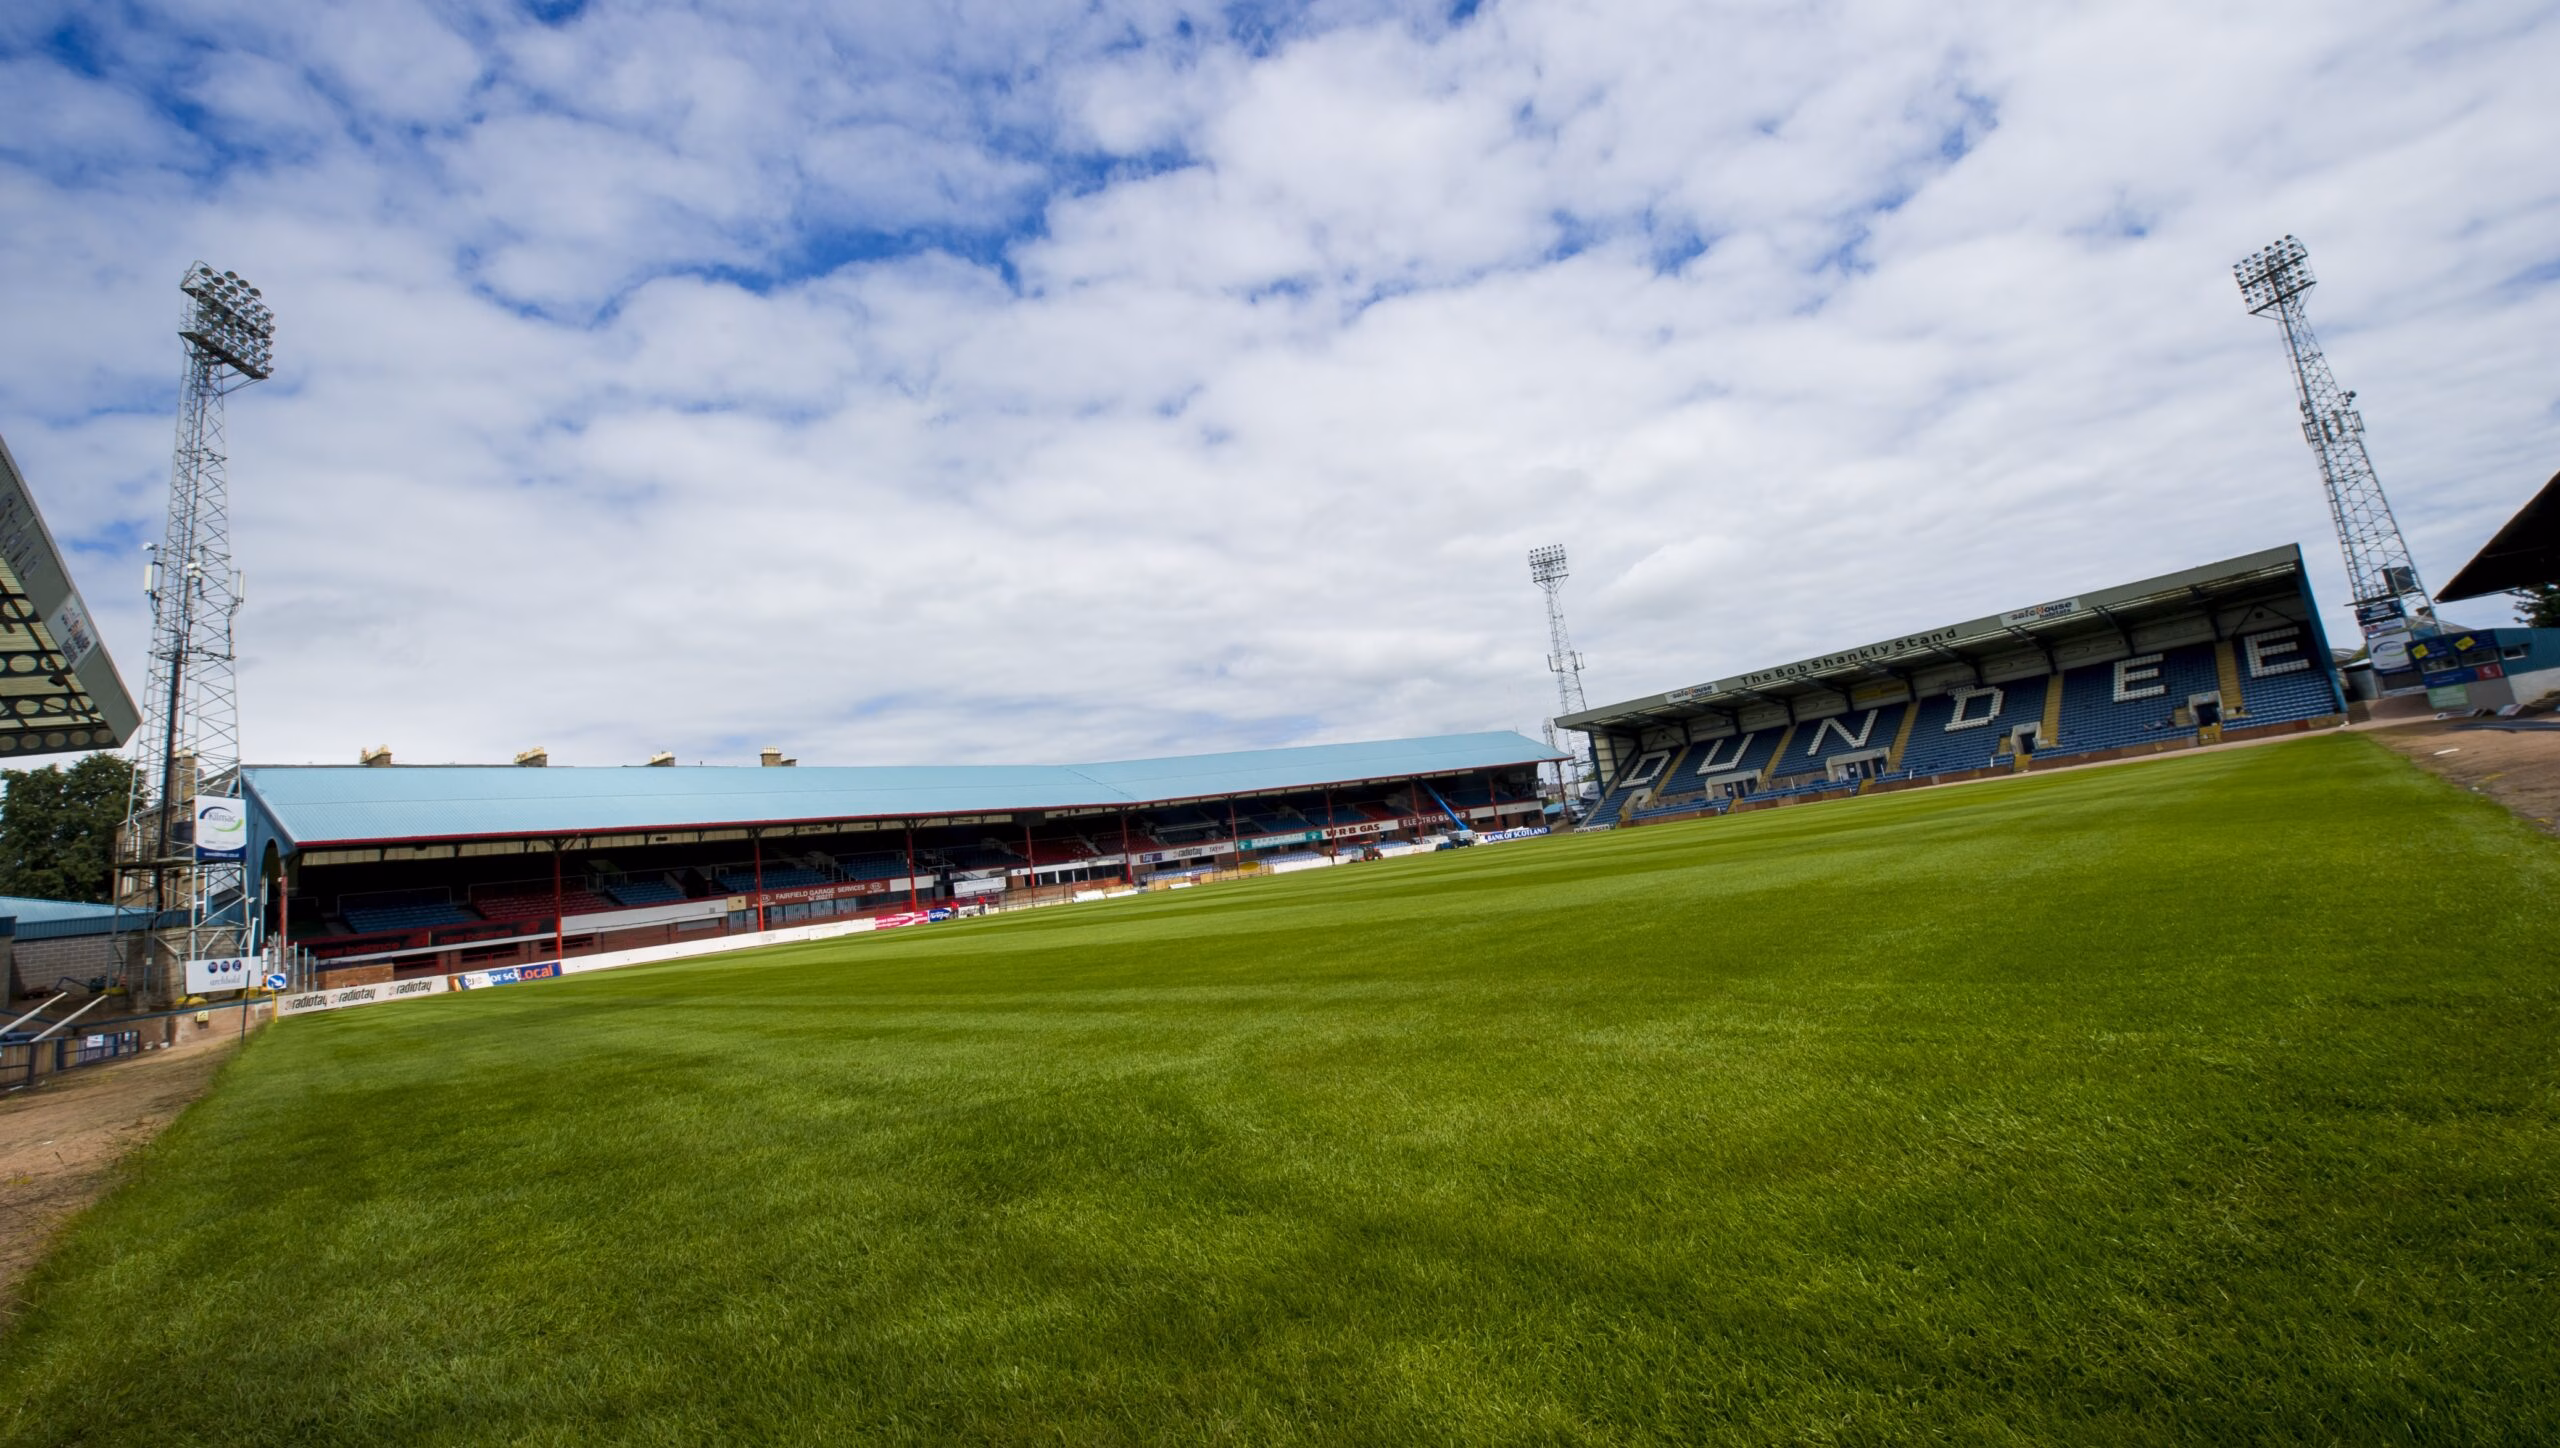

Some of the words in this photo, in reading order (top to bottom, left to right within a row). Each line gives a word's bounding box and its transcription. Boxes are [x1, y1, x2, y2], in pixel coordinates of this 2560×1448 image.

[1741, 673, 1773, 686] The
[1775, 663, 1808, 679] Bob
[1811, 643, 1889, 671] Shankly
[1895, 628, 1957, 650] Stand
[1403, 814, 1437, 828] ELETRO
[1438, 811, 1467, 822] GURD
[1486, 833, 1504, 843] BANK
[1504, 832, 1513, 840] OF
[1513, 826, 1548, 839] SCOTLAND
[775, 890, 808, 900] FAIRFIELD
[809, 887, 835, 897] GARAGE
[837, 884, 866, 893] SERVICES
[338, 988, 376, 1003] radiotay
[396, 981, 433, 995] radiotay
[291, 995, 328, 1010] radiotay
